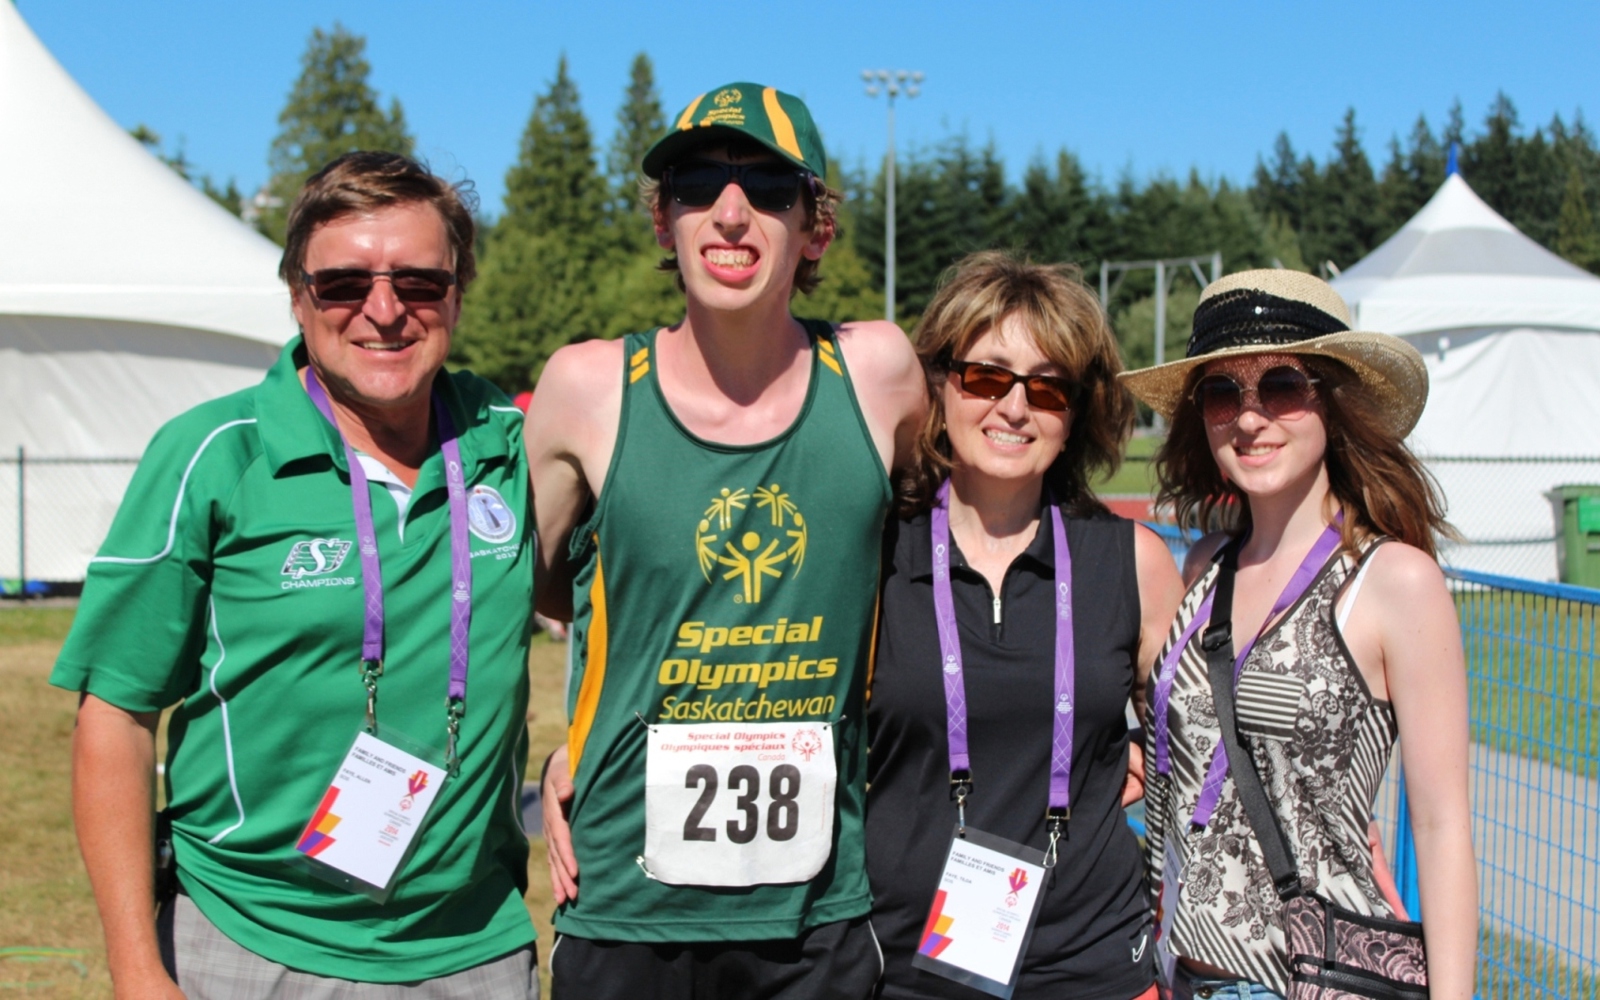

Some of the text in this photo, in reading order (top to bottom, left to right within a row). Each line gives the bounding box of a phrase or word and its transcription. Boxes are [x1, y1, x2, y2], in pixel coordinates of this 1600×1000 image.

[281, 577, 356, 590] CHAMPIONS
[677, 616, 823, 653] Special
[658, 655, 838, 690] Olympics
[659, 693, 835, 721] Saskatchewan
[687, 731, 786, 741] Special Olympics
[661, 742, 786, 753] Olympiques spéciaux
[758, 753, 786, 762] Canada
[682, 763, 802, 845] 238
[950, 856, 976, 869] FAMILLES
[983, 867, 997, 876] AMIS
[952, 851, 1006, 873] FAMILY AND FRIENDS
[996, 921, 1010, 932] 2014
